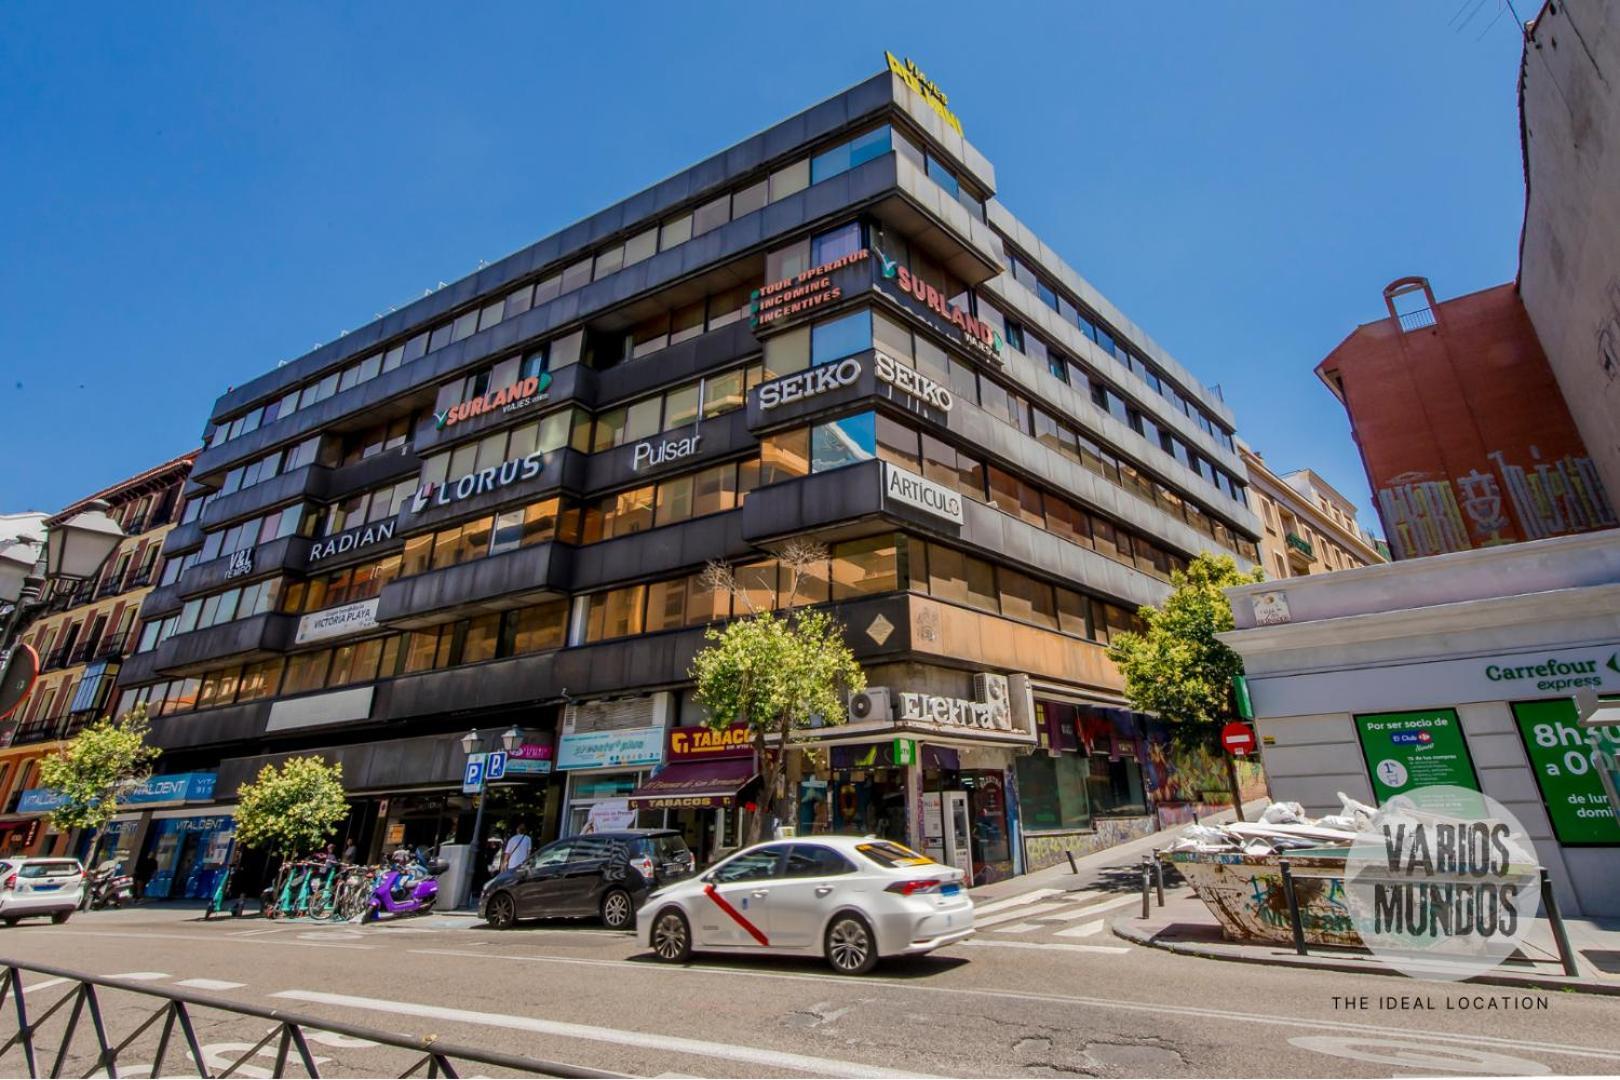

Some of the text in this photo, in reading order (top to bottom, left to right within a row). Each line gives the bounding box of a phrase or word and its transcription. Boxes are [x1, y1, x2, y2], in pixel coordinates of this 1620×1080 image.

[760, 248, 870, 297] TOUR OPERATOR
[759, 287, 842, 324] INCENTIVES
[760, 277, 831, 311] INCOMING
[897, 265, 994, 348] SURLAND
[759, 358, 862, 411] SEIKO
[874, 351, 953, 412] SEIKO
[446, 375, 539, 425] SURLAND
[633, 434, 700, 472] Pulsar
[437, 450, 544, 506] LORUS
[309, 520, 396, 562] RADIAN
[347, 608, 371, 621] PLAYA
[1484, 659, 1598, 683] Carrefour
[1536, 674, 1602, 693] express
[1367, 722, 1384, 731] Por
[1404, 718, 1432, 728] socio
[1434, 717, 1448, 726] de
[467, 765, 480, 784] P
[490, 754, 501, 776] P
[1546, 763, 1560, 776] a
[648, 797, 712, 808] TABACOS
[1568, 794, 1586, 804] de
[176, 818, 225, 832] VITALDENT
